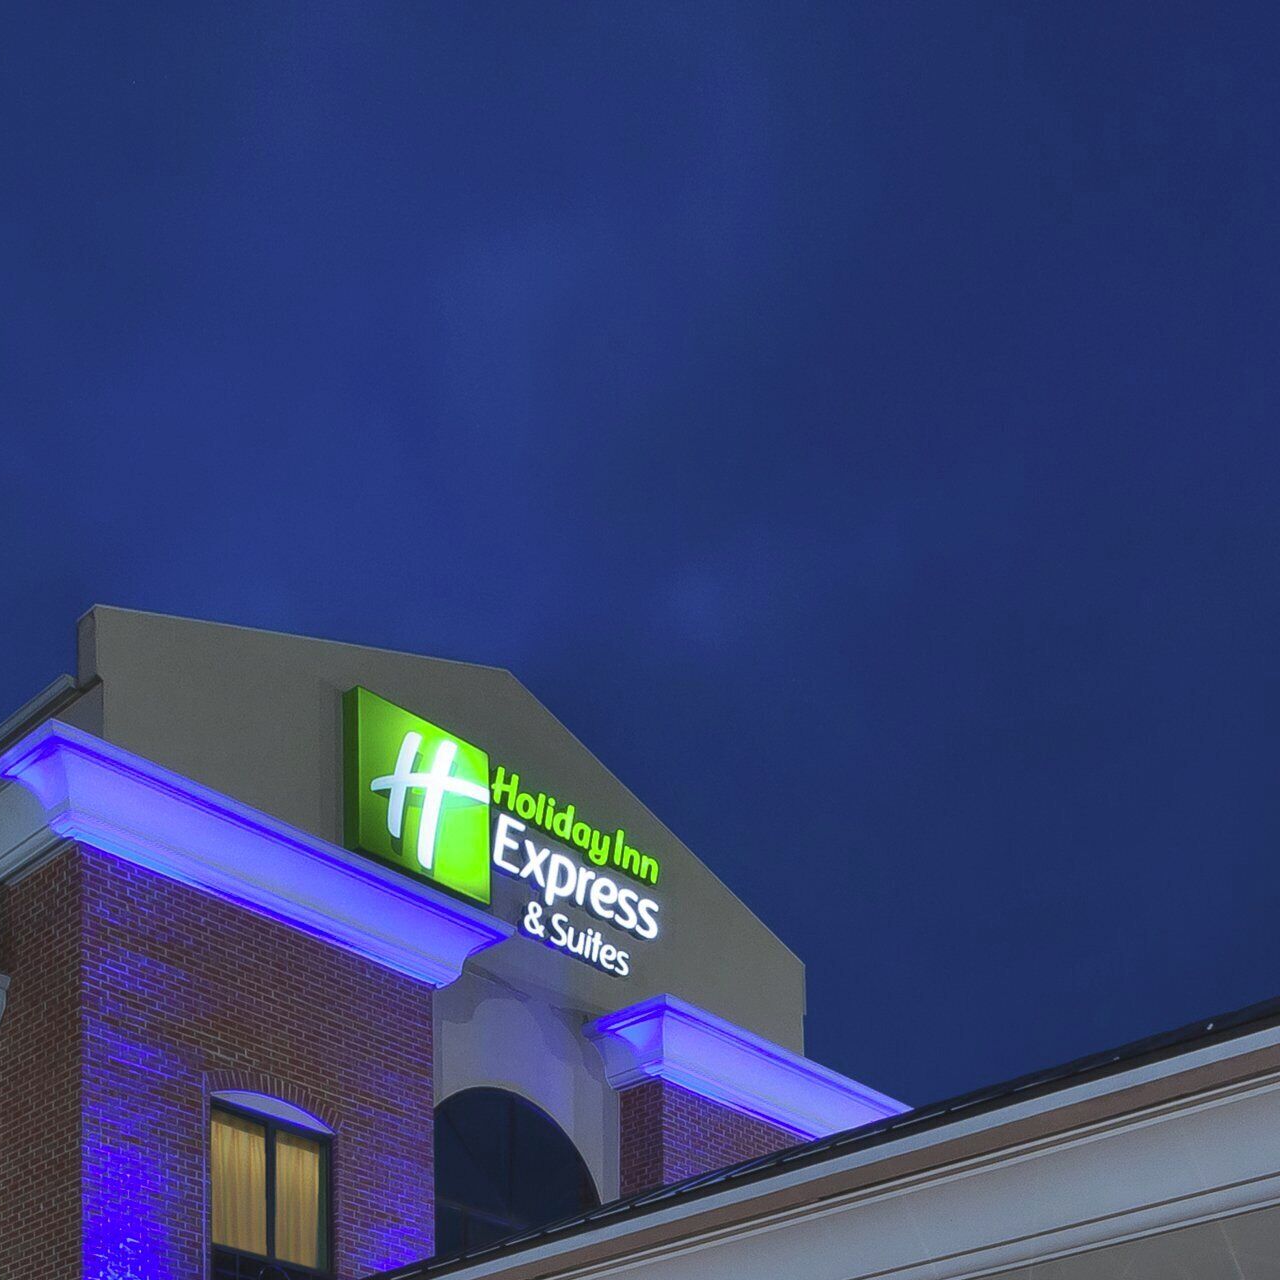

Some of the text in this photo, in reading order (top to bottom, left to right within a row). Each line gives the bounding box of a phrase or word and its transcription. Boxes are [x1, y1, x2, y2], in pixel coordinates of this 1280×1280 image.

[491, 766, 659, 884] Holiday Inn
[493, 813, 659, 939] Express
[523, 901, 629, 976] & Suites
